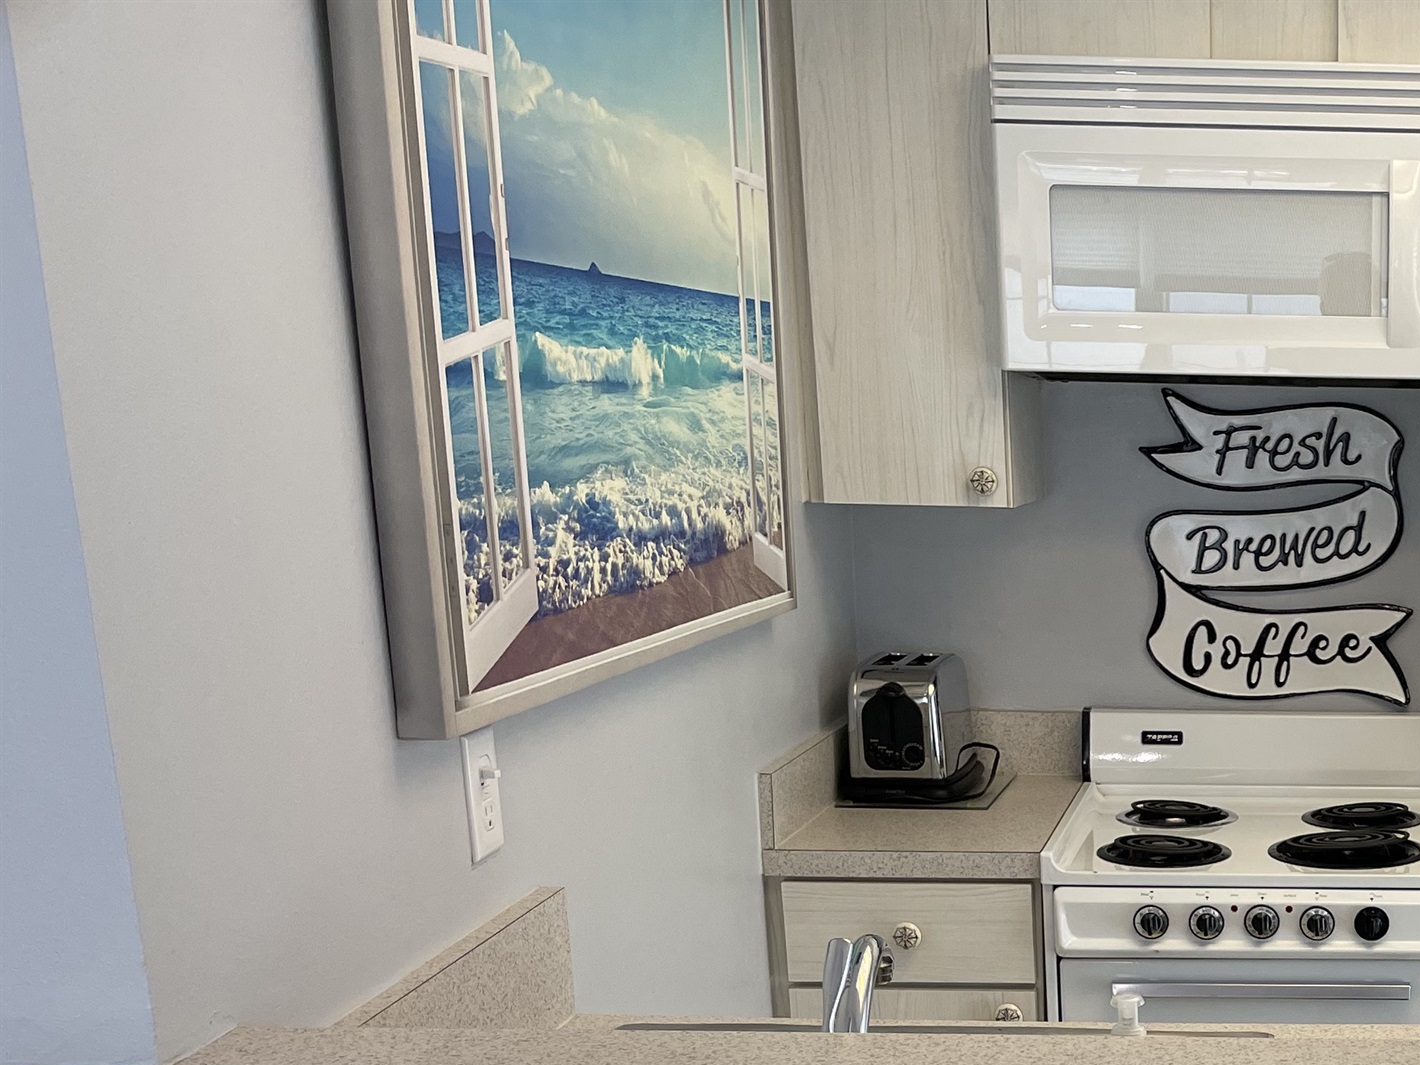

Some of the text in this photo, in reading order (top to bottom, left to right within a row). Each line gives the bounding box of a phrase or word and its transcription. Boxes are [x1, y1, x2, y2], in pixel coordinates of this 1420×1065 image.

[1213, 417, 1362, 476] Fresh
[1186, 510, 1371, 574] Brewed
[1183, 619, 1372, 689] Coffee
